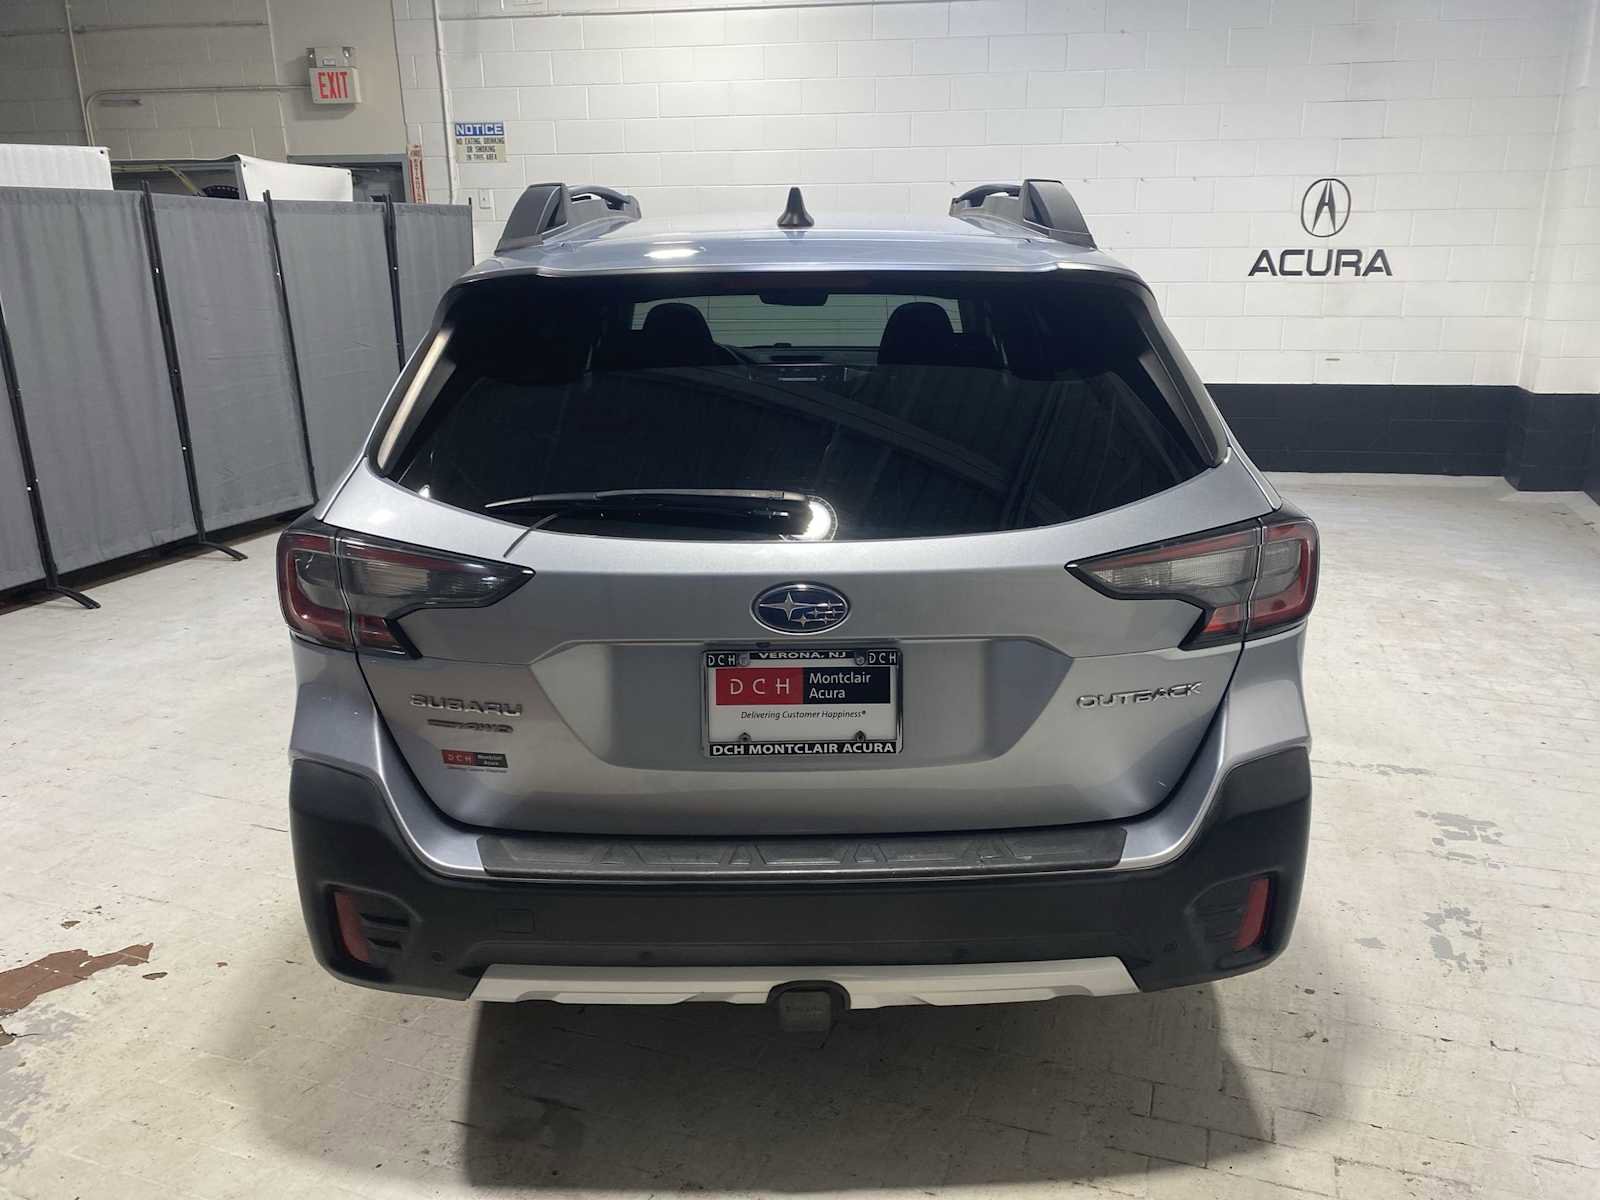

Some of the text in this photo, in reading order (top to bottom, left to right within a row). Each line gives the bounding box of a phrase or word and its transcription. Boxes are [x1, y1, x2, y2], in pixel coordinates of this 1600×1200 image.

[317, 71, 348, 99] EXIT
[455, 124, 503, 135] NOTICE
[1248, 249, 1392, 276] ACURA
[828, 651, 847, 659] NJ
[809, 672, 871, 684] Montclair
[809, 687, 846, 699] Acura
[1077, 681, 1202, 709] OUTBACK
[409, 693, 522, 717] SUBARU
[741, 710, 780, 720] Delivering
[782, 710, 819, 719] Customer
[712, 742, 895, 756] DCH MONTCLAIR ACURA
